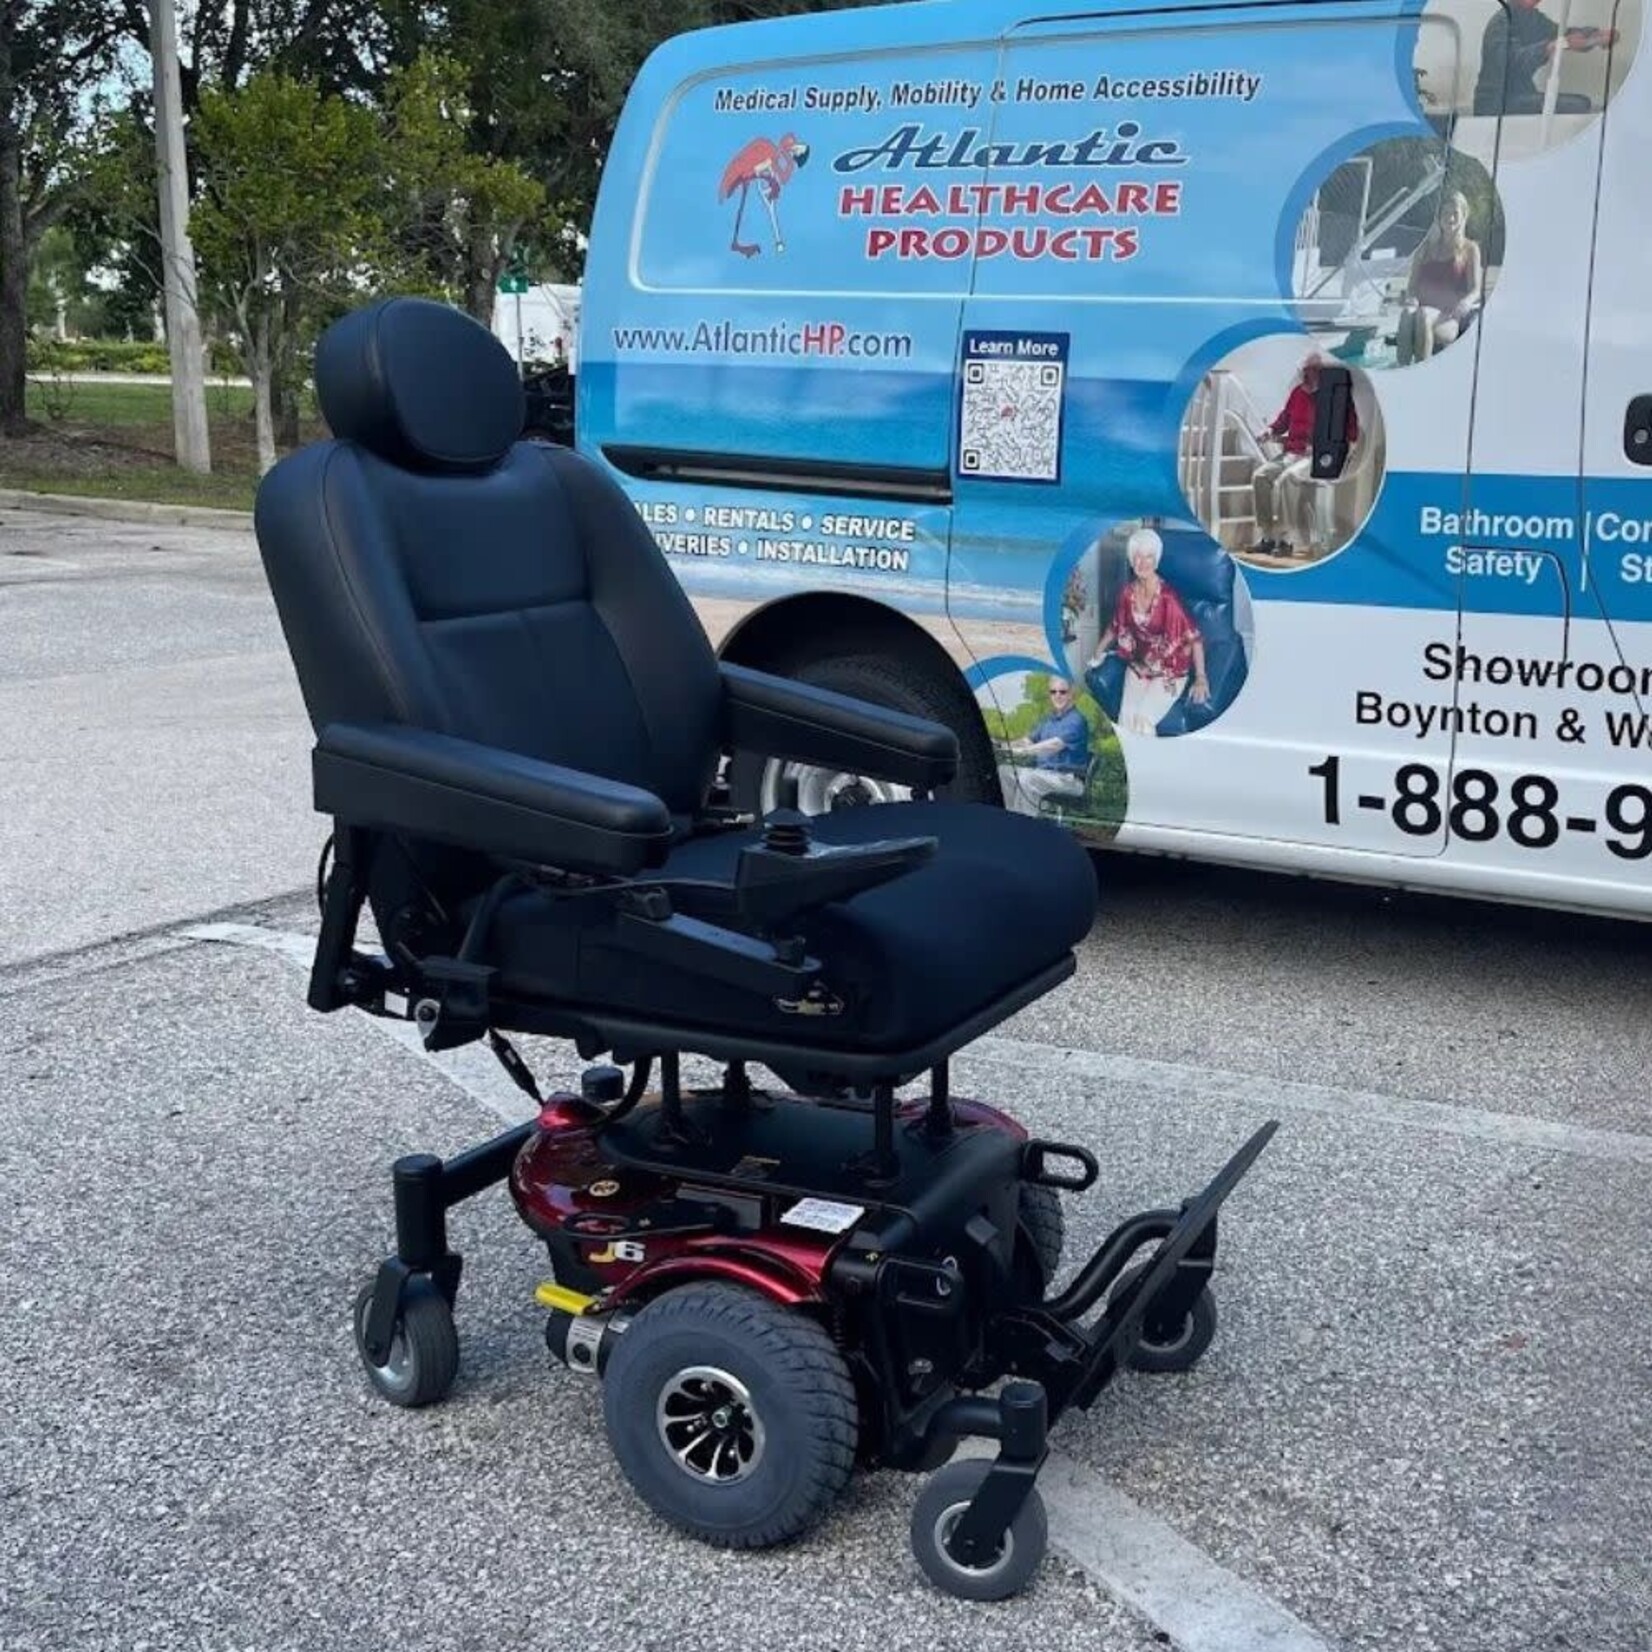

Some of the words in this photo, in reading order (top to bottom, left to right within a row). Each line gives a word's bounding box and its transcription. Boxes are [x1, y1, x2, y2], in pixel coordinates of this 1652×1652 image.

[714, 88, 797, 111] Medical
[804, 86, 883, 113] Supply,
[891, 82, 982, 109] Mobility
[990, 81, 1006, 102] &
[1016, 78, 1085, 102] Home
[1093, 72, 1261, 101] Accessibility
[832, 121, 1188, 172] Atlantic
[839, 181, 1181, 218] HEALTHCARE
[866, 228, 1140, 261] PRODUCTS
[614, 321, 912, 358] www.AtlanticHP.com
[969, 337, 1014, 354] Learn
[1017, 340, 1059, 357] More
[703, 506, 794, 532] RENTALS
[821, 515, 915, 541] SERVICE
[1420, 506, 1574, 540] Bathroom
[757, 539, 910, 571] INSTALLATION
[1445, 547, 1543, 584] Safety
[1355, 691, 1538, 739] Boynton
[1556, 708, 1586, 744] &
[1605, 711, 1652, 751] W
[1308, 755, 1652, 860] 1-888-9
[589, 1241, 646, 1263] J6
